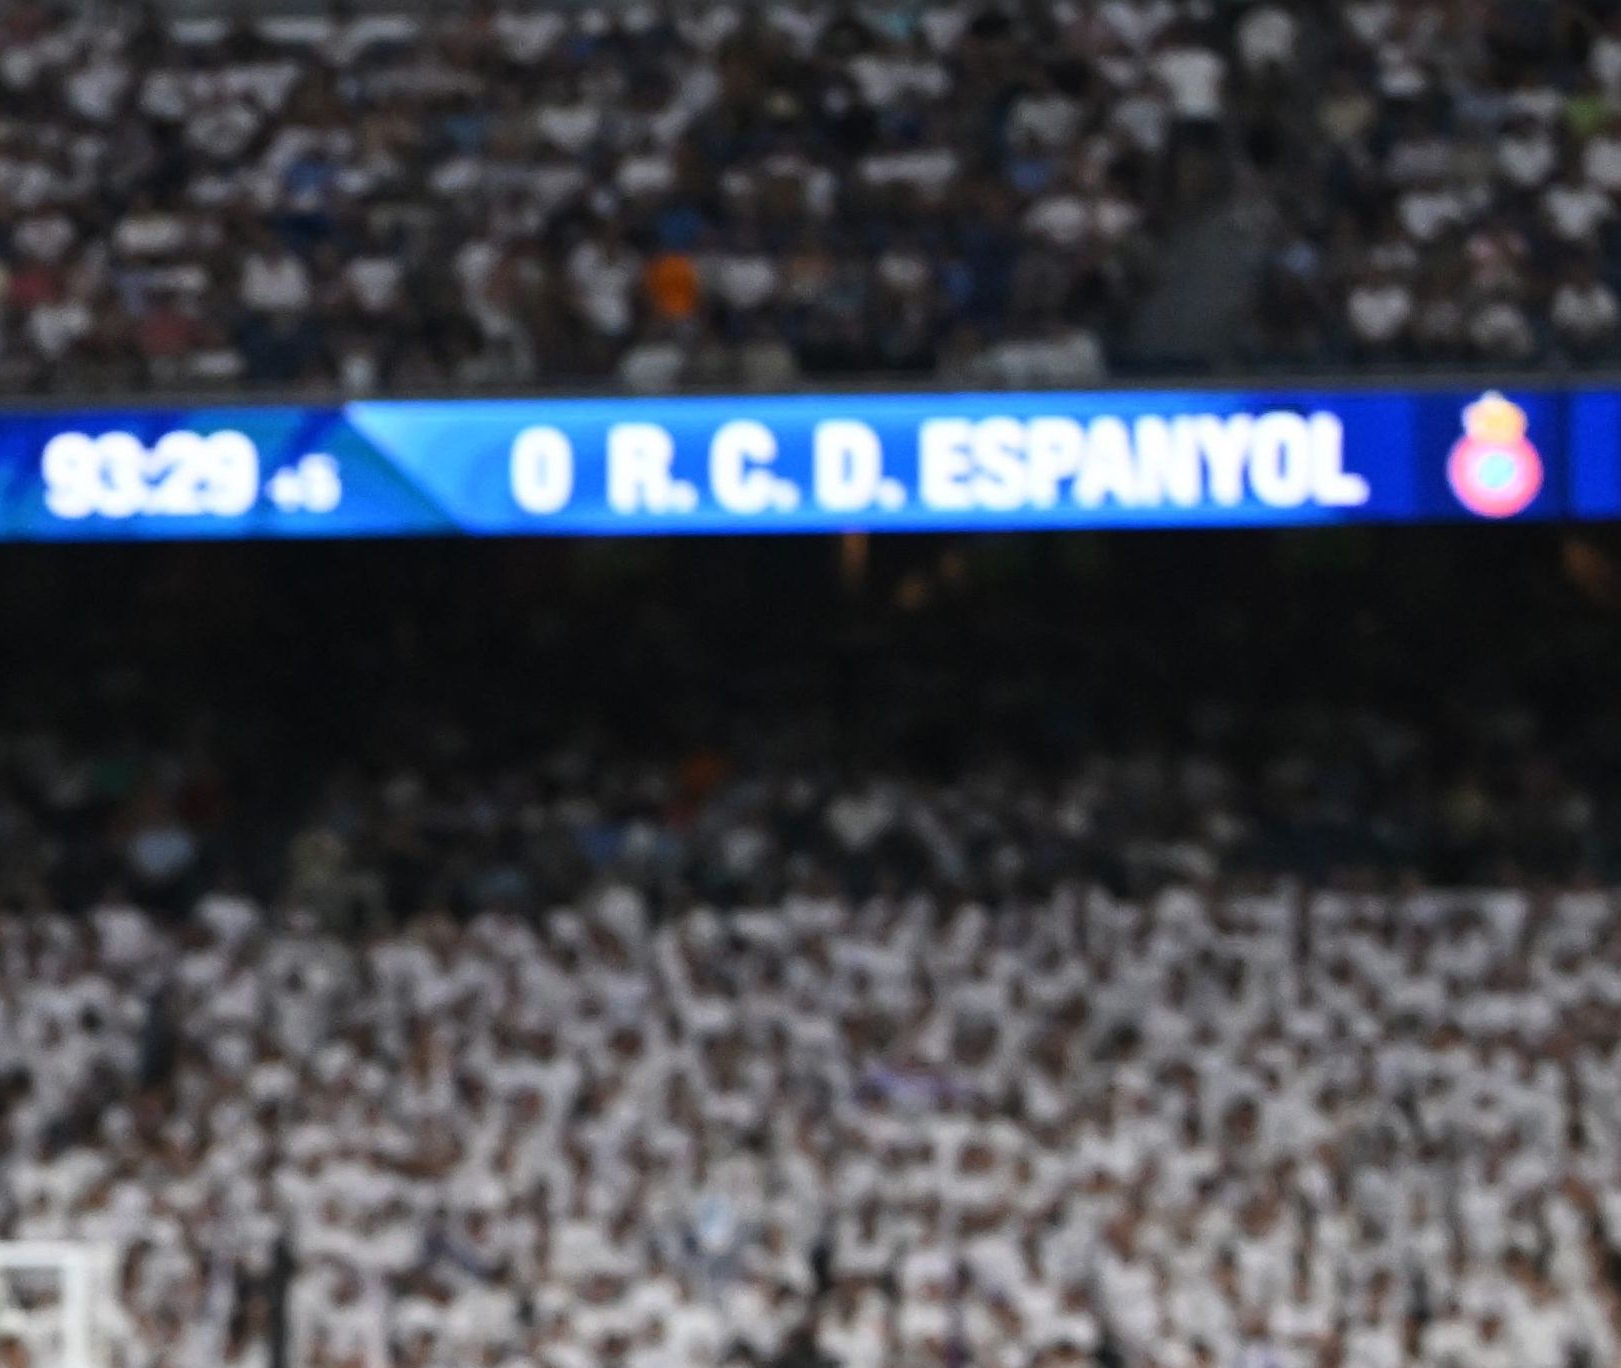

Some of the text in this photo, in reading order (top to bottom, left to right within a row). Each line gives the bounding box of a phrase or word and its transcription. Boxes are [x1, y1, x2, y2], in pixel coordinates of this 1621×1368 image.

[42, 430, 259, 519] 93:29
[607, 422, 699, 514] R.
[709, 419, 800, 515] C.
[813, 418, 907, 513] D.
[918, 411, 1369, 512] ESPANYOL
